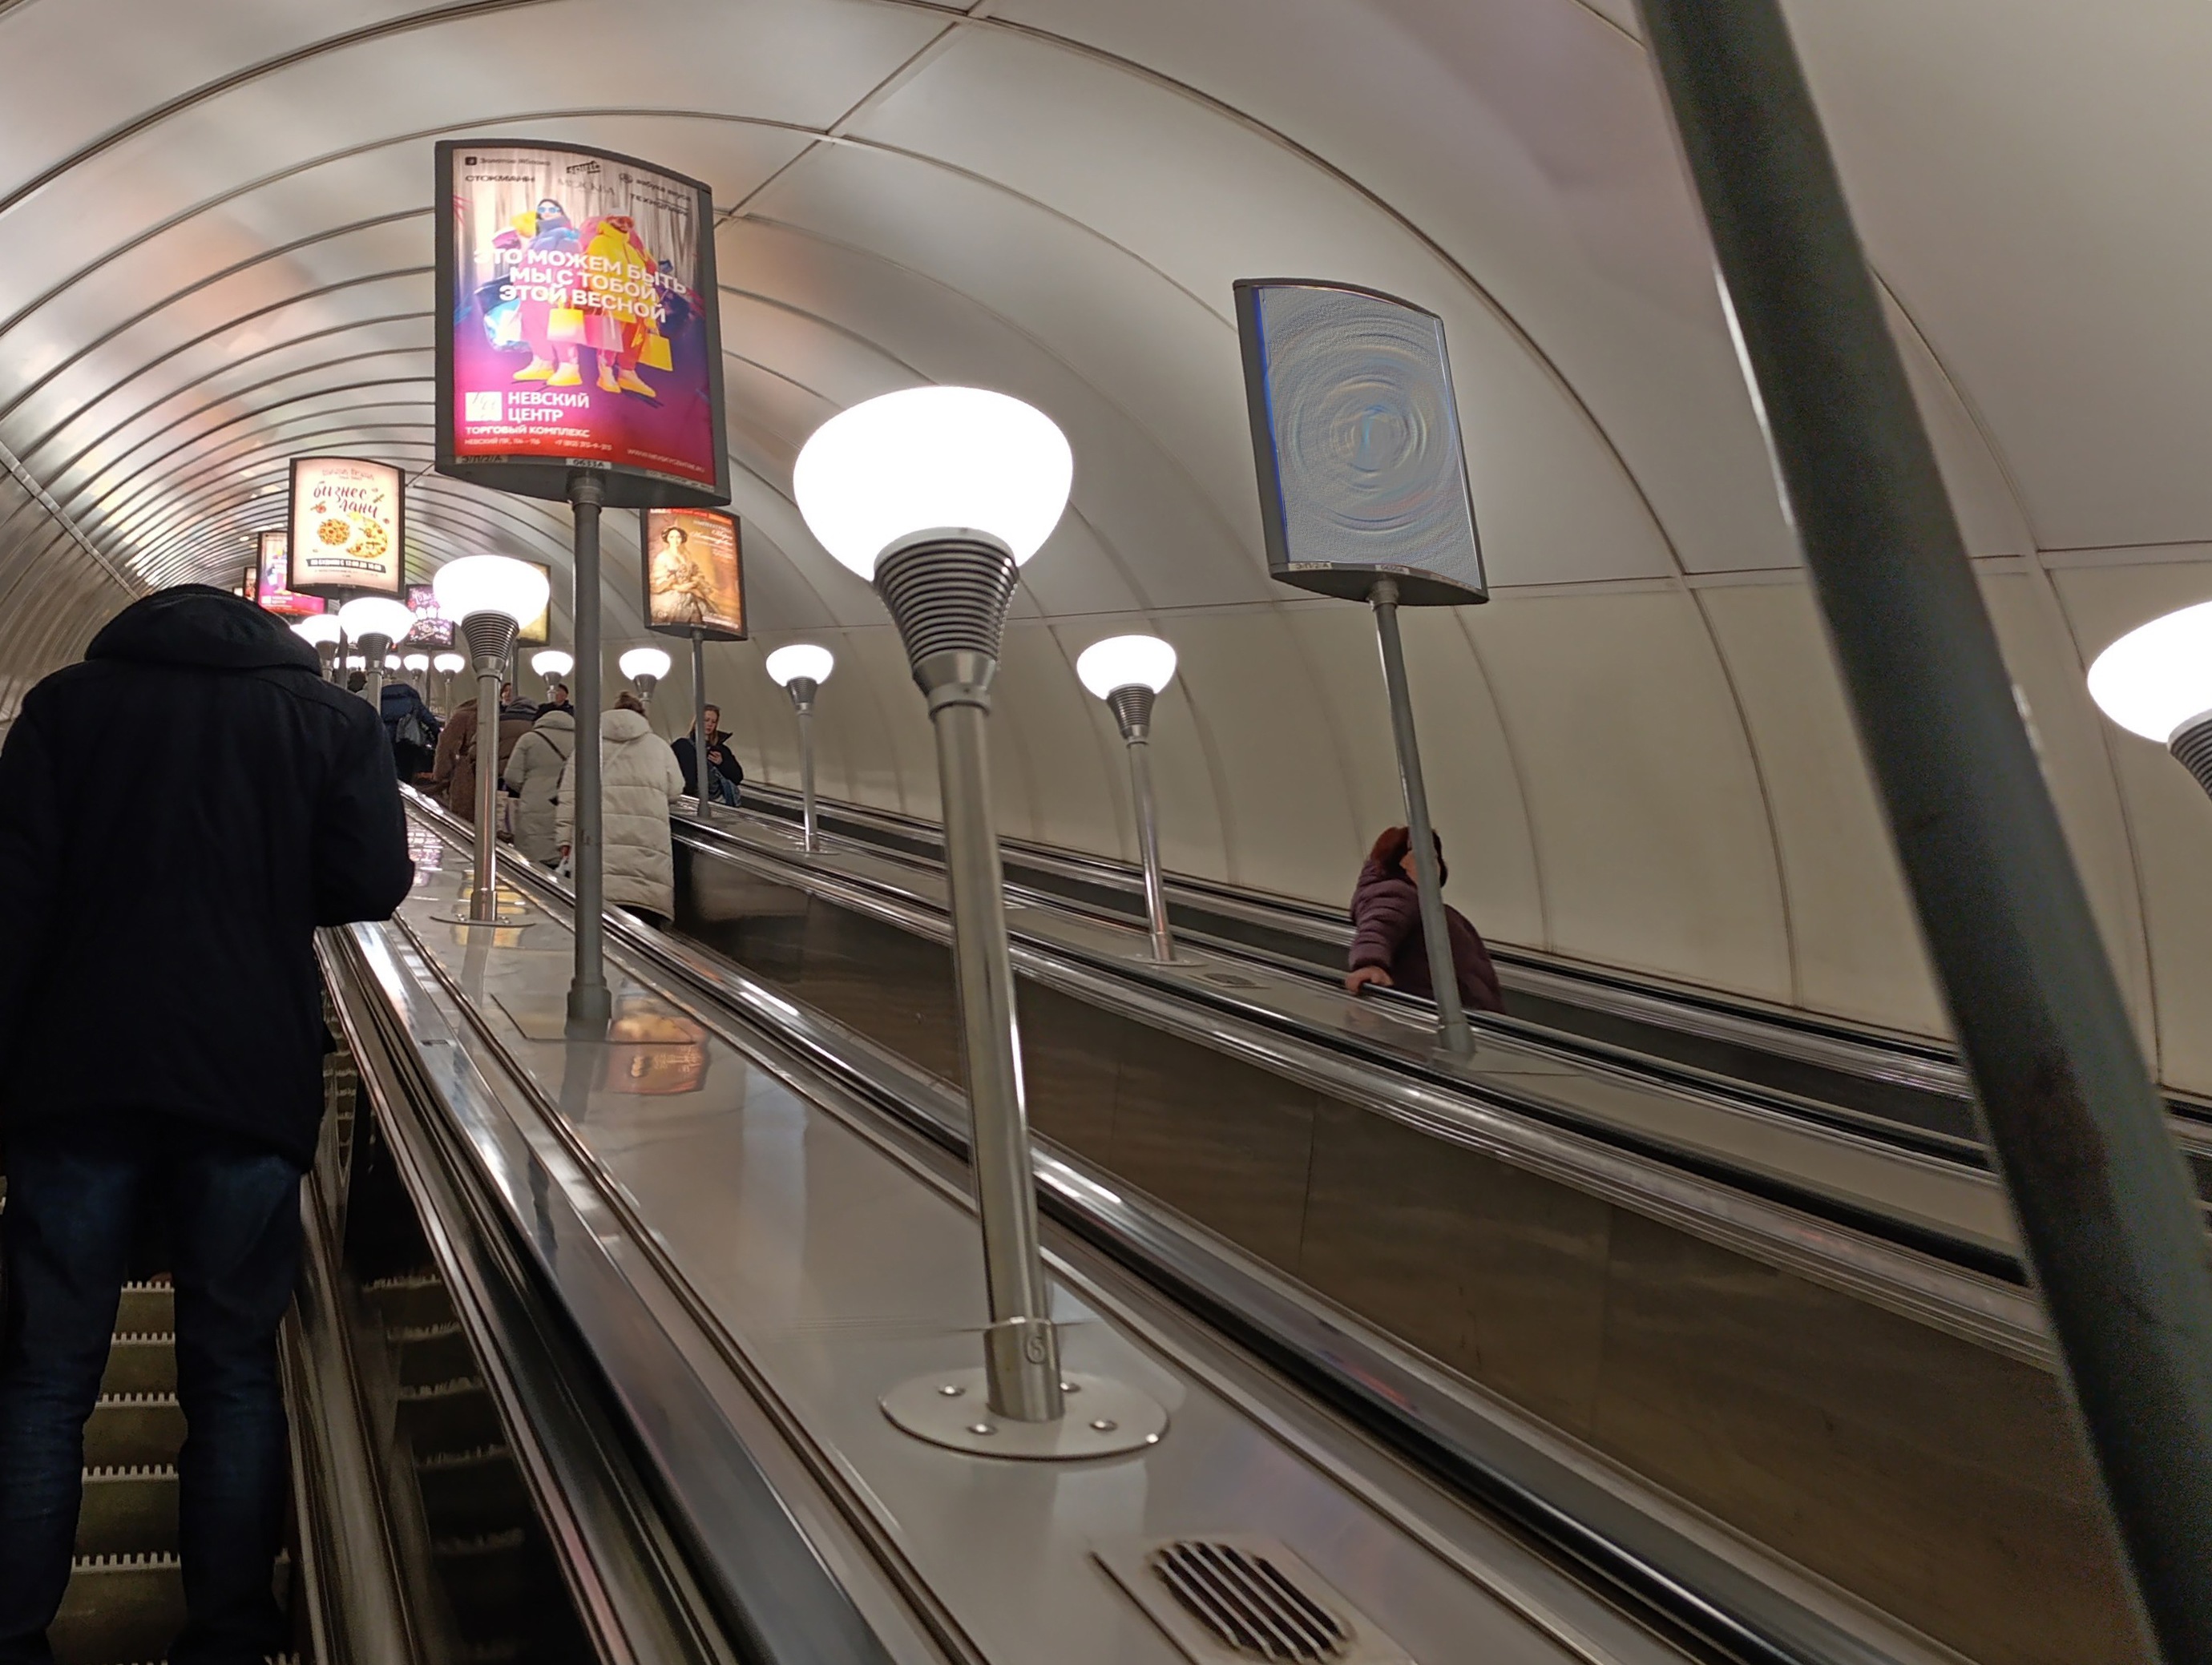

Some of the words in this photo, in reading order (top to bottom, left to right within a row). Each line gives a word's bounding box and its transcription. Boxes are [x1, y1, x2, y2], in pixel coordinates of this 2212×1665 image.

[474, 248, 523, 264] ЭТО
[527, 248, 621, 276] МОЖЕМ
[628, 264, 687, 295] БЫТЬ
[510, 266, 552, 284] МЫ
[556, 269, 574, 286] С
[577, 271, 657, 301] ТОБОЙ
[499, 283, 567, 304] ЭТОЙ
[571, 288, 667, 324] ВЕСНОЙ
[507, 391, 590, 409] НЕВСКИЙ
[507, 408, 564, 423] ЦЕНТР
[465, 425, 527, 435] ТОРГОВЫЙ
[529, 426, 591, 438] КОМПЛЕКС
[313, 481, 367, 503] бизнес
[339, 498, 378, 519] ланч
